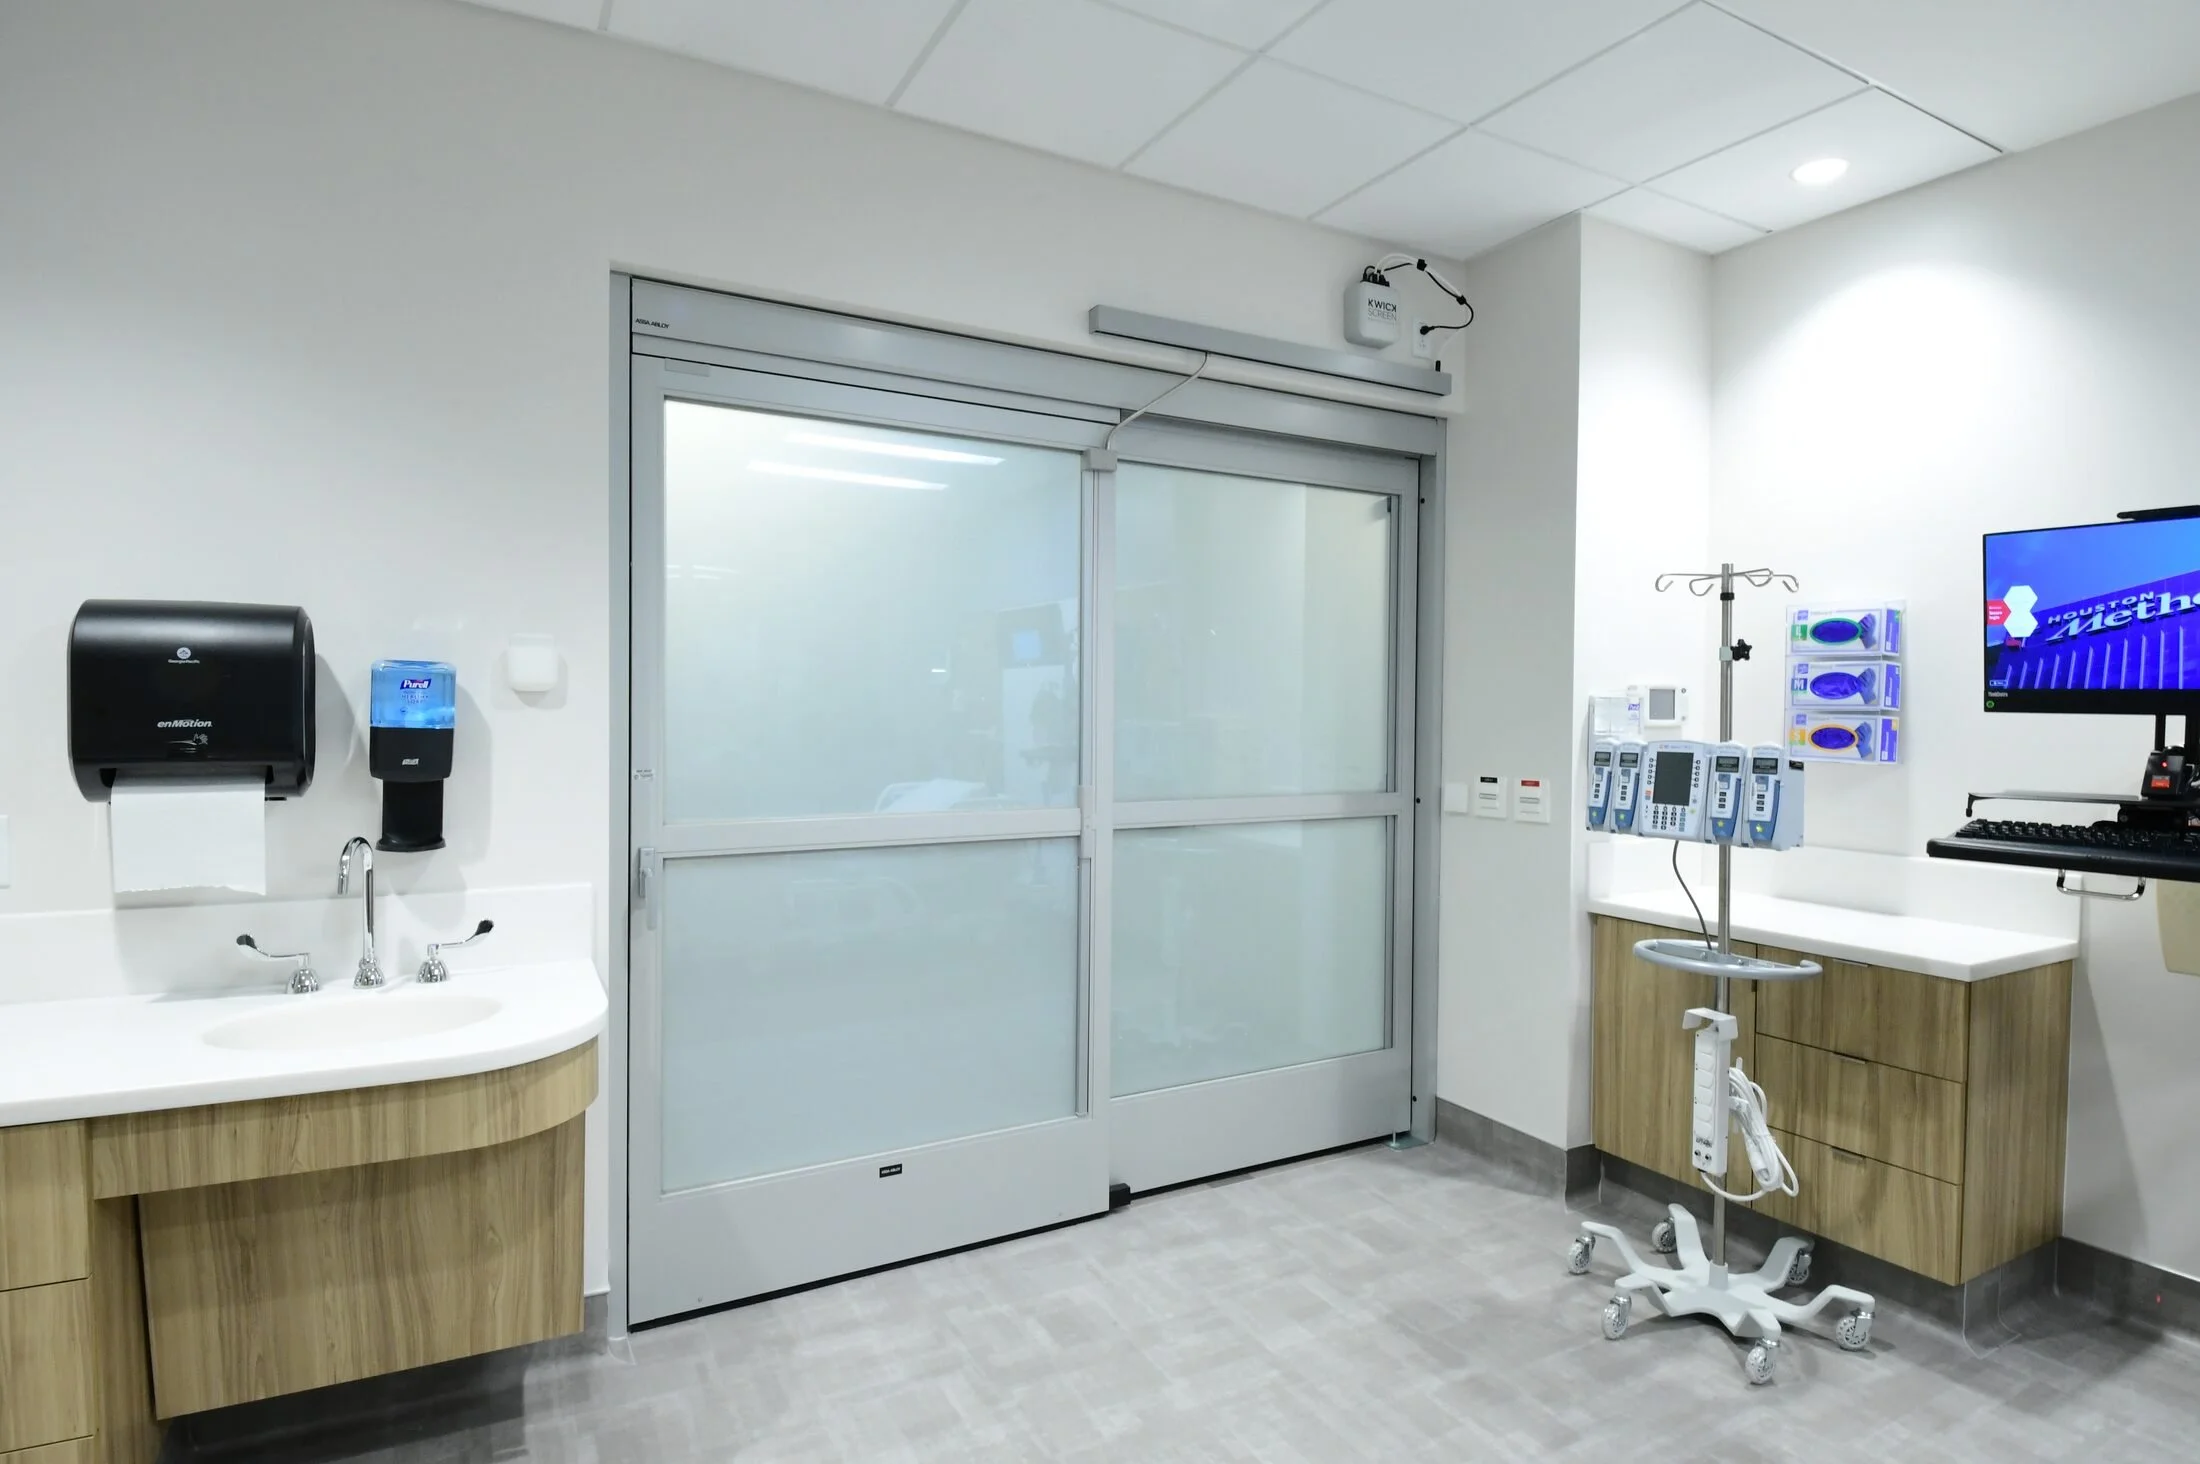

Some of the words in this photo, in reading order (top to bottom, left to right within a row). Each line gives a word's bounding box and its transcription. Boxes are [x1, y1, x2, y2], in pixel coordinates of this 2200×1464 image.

[1367, 297, 1397, 313] KWICK
[1367, 309, 1397, 321] SCREEN
[2047, 591, 2155, 624] HOUSTON
[157, 718, 212, 728] enMotion
